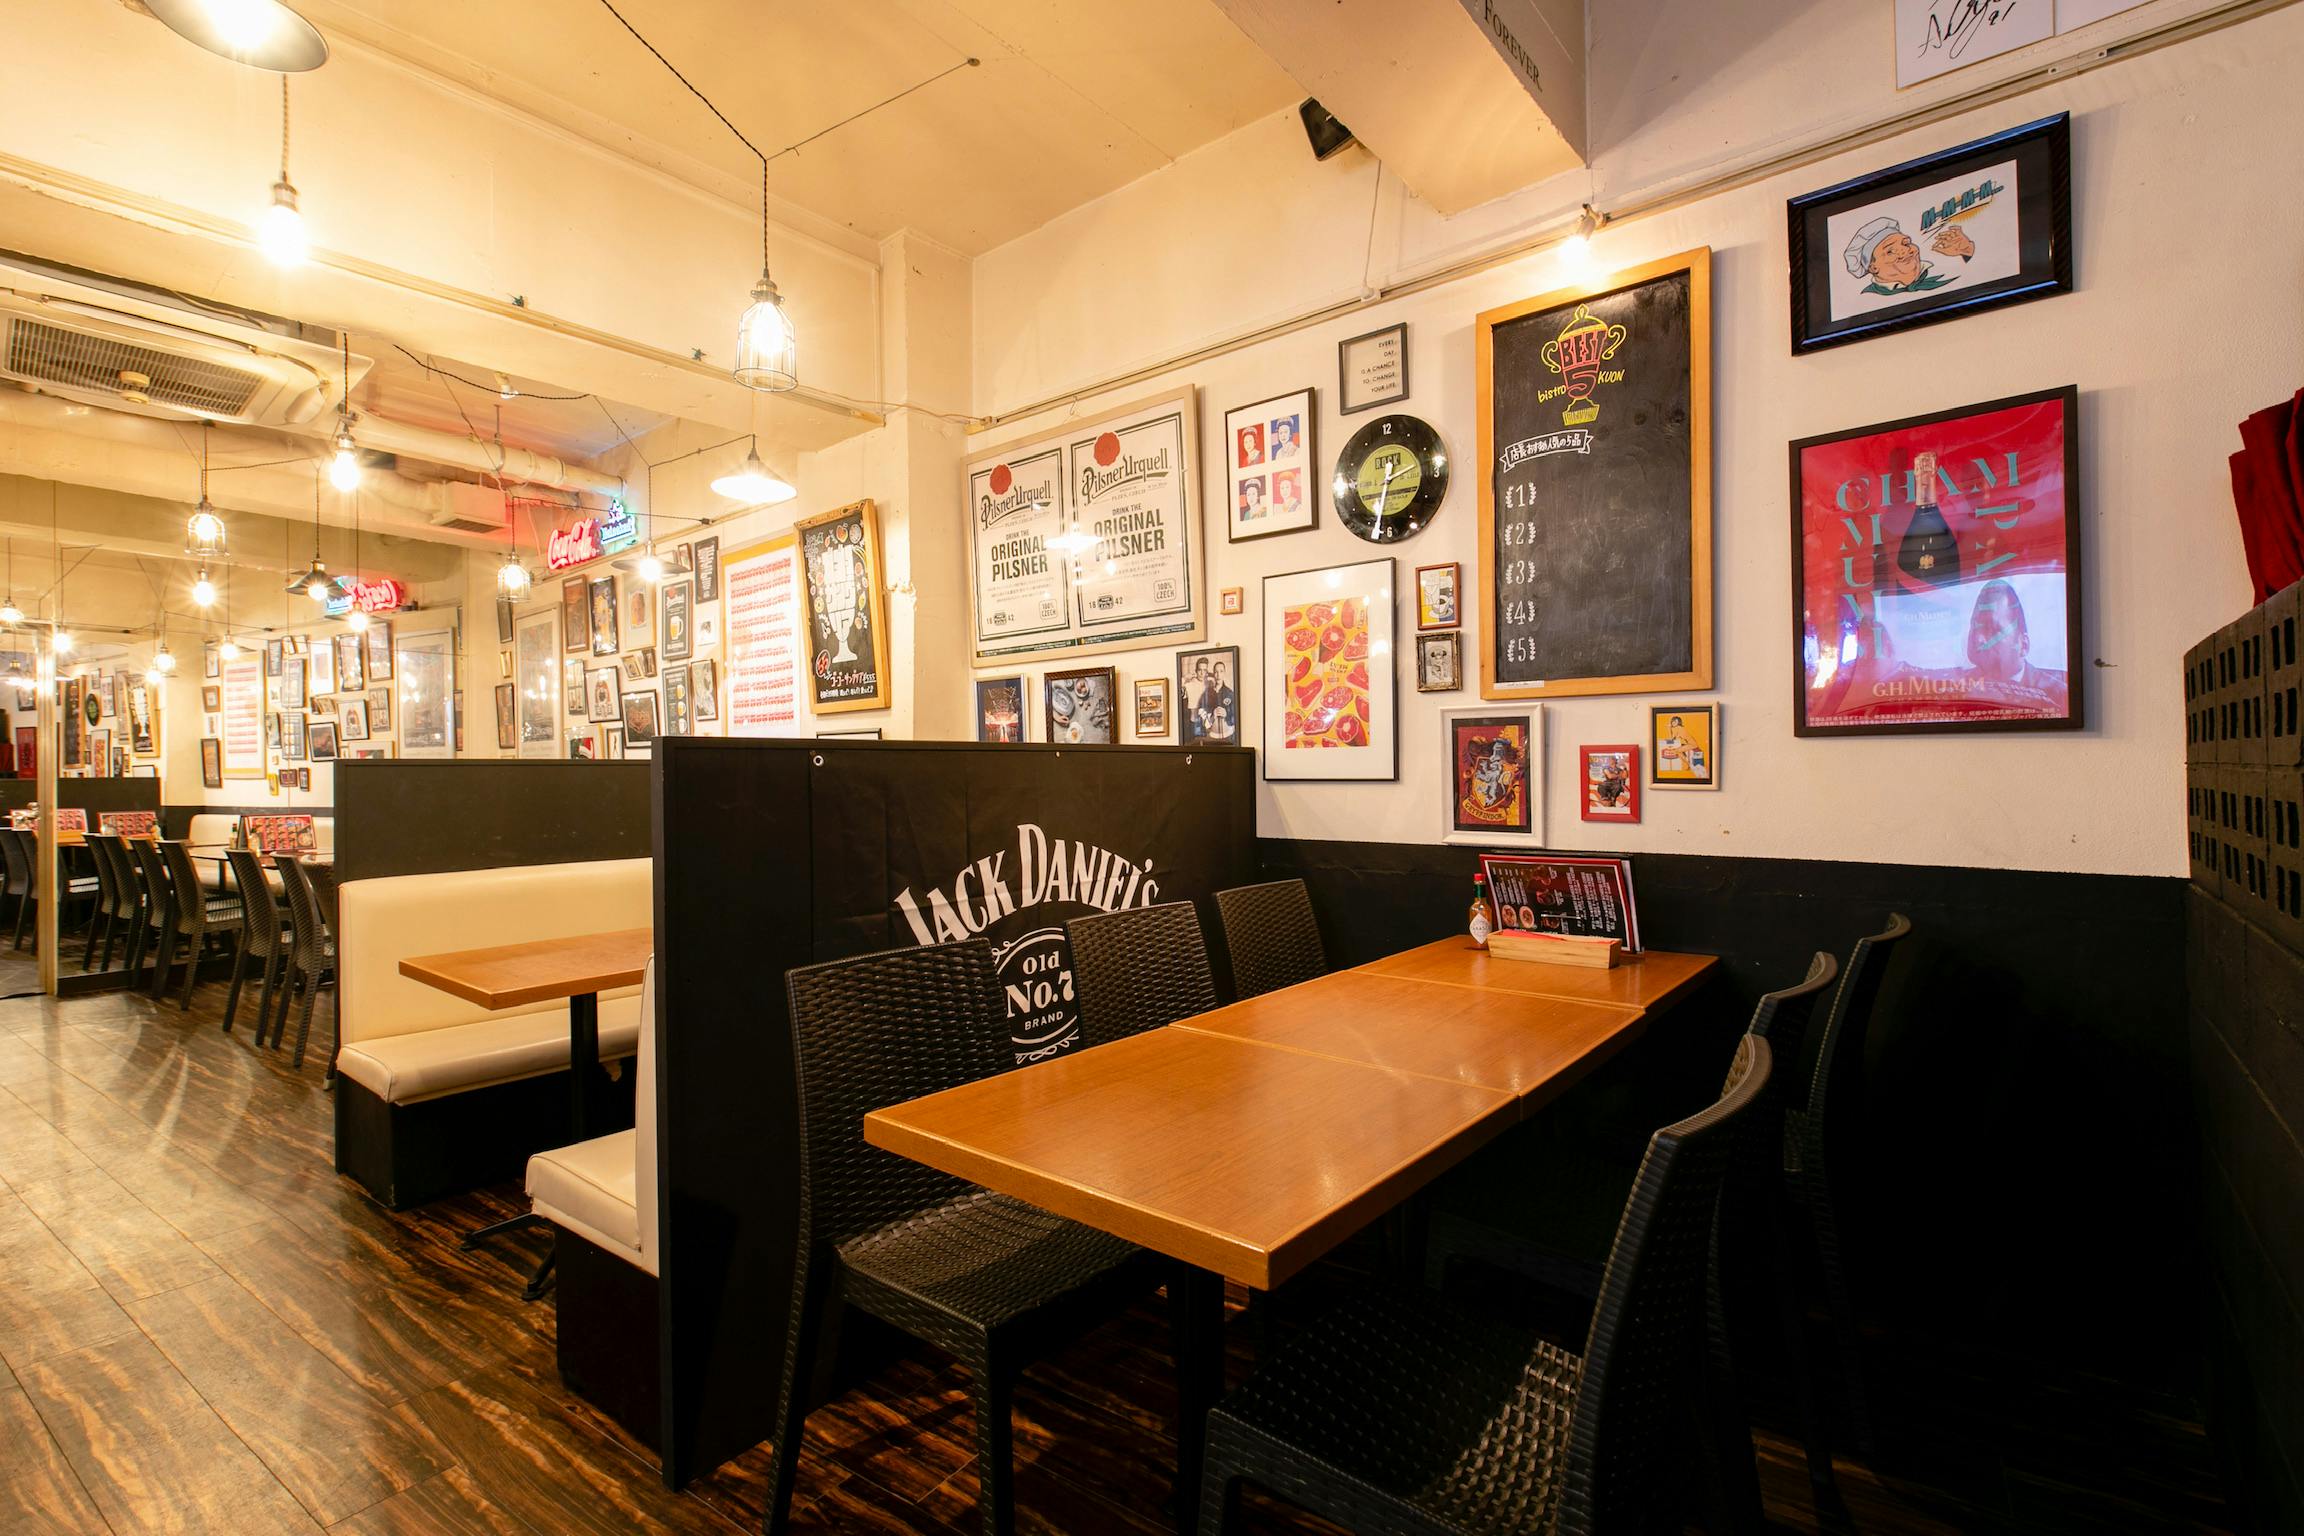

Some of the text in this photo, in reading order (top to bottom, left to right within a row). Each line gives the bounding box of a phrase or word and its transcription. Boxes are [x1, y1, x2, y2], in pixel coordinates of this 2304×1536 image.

[1559, 330, 1607, 369] BEST
[1597, 369, 1625, 384] KUON
[1537, 385, 1567, 403] bistro
[1382, 423, 1392, 435] 12
[1081, 448, 1168, 506] Pilsner Urquell
[1433, 467, 1440, 478] 3
[980, 491, 1015, 531] Pilsner
[1013, 480, 1052, 511] Urquell
[1516, 483, 1525, 507] 1
[1112, 503, 1142, 516] DRINK THE
[1005, 529, 1030, 541] DRINK THE
[1094, 508, 1164, 540] ORIGINAL
[1386, 527, 1393, 538] 6
[1515, 521, 1525, 546] 2
[991, 534, 1047, 561] ORIGINAL
[1095, 528, 1165, 562] PILSNER
[992, 554, 1048, 582] PILSNER
[1515, 560, 1525, 585] 3
[1114, 597, 1123, 606] 42
[1156, 589, 1175, 600] CZECH
[1513, 600, 1525, 625] 4
[1518, 637, 1526, 662] 5
[894, 849, 1017, 946] JACK
[1024, 1010, 1064, 1031] BRAND
